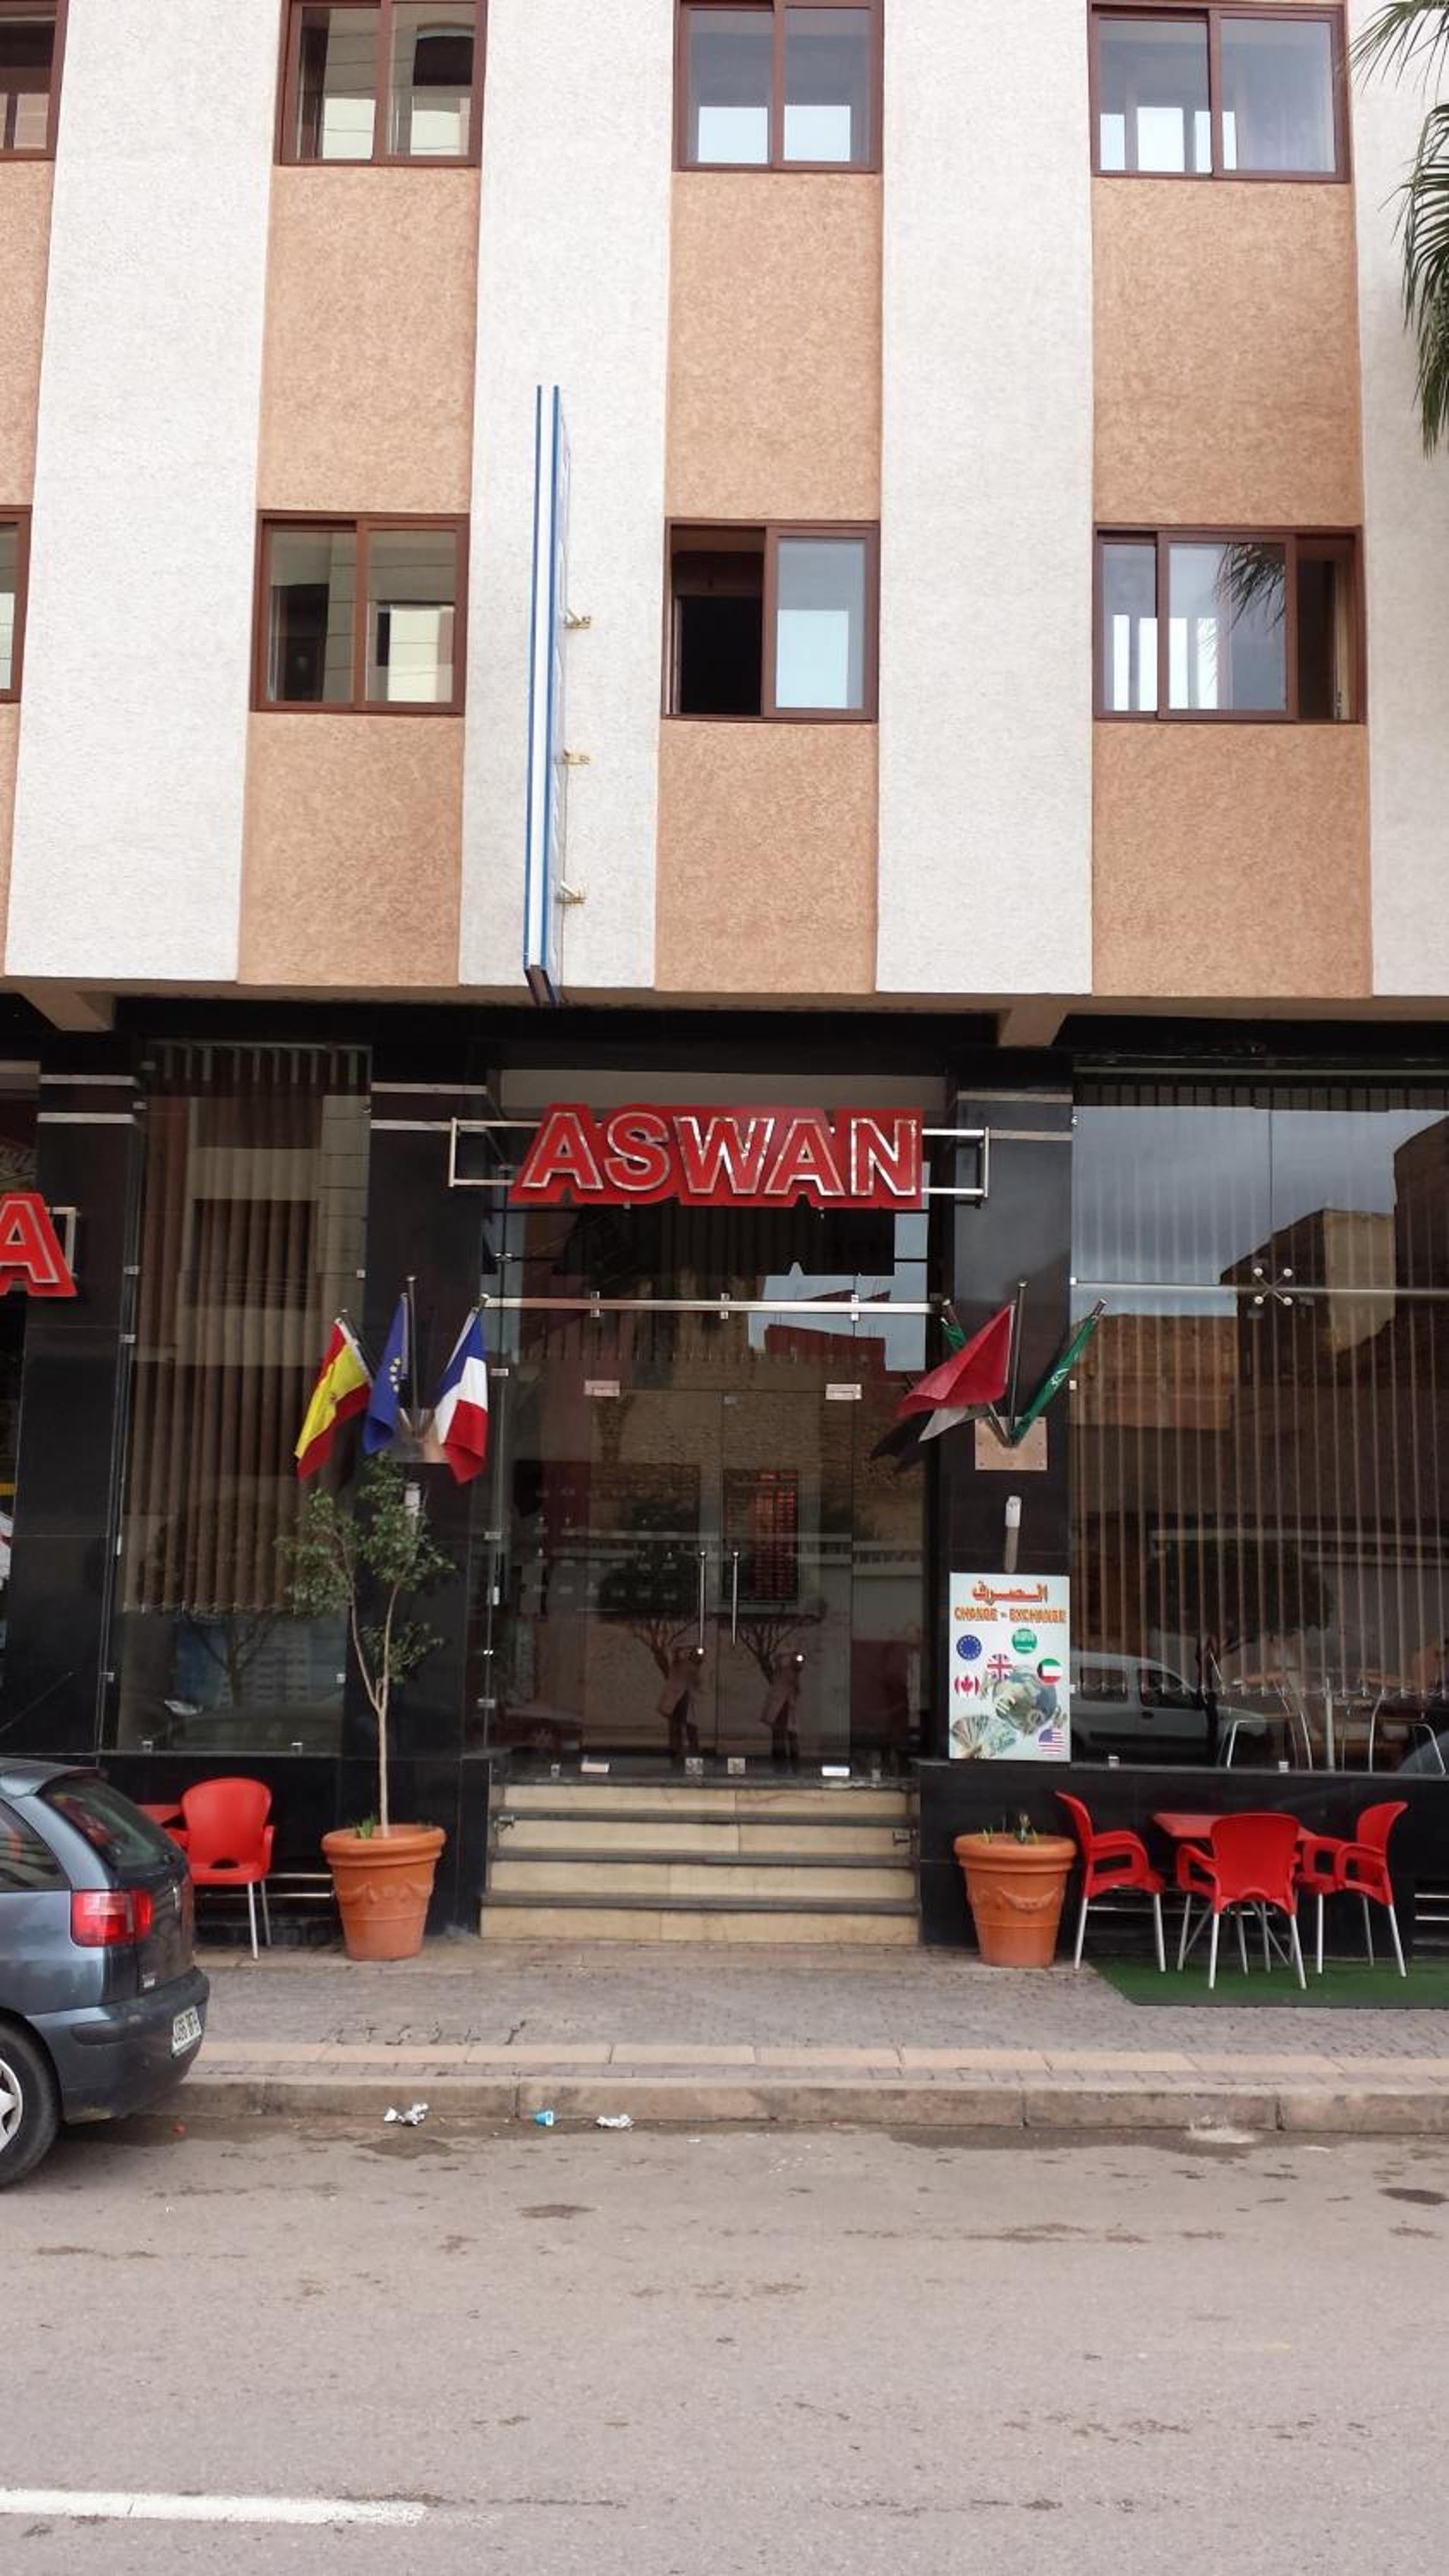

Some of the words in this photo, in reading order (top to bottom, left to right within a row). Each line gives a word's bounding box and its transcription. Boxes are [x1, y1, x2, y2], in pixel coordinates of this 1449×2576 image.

[518, 1110, 919, 1200] ASWAN
[955, 1607, 997, 1621] CHANGE
[1009, 1608, 1066, 1623] EXCHANGE
